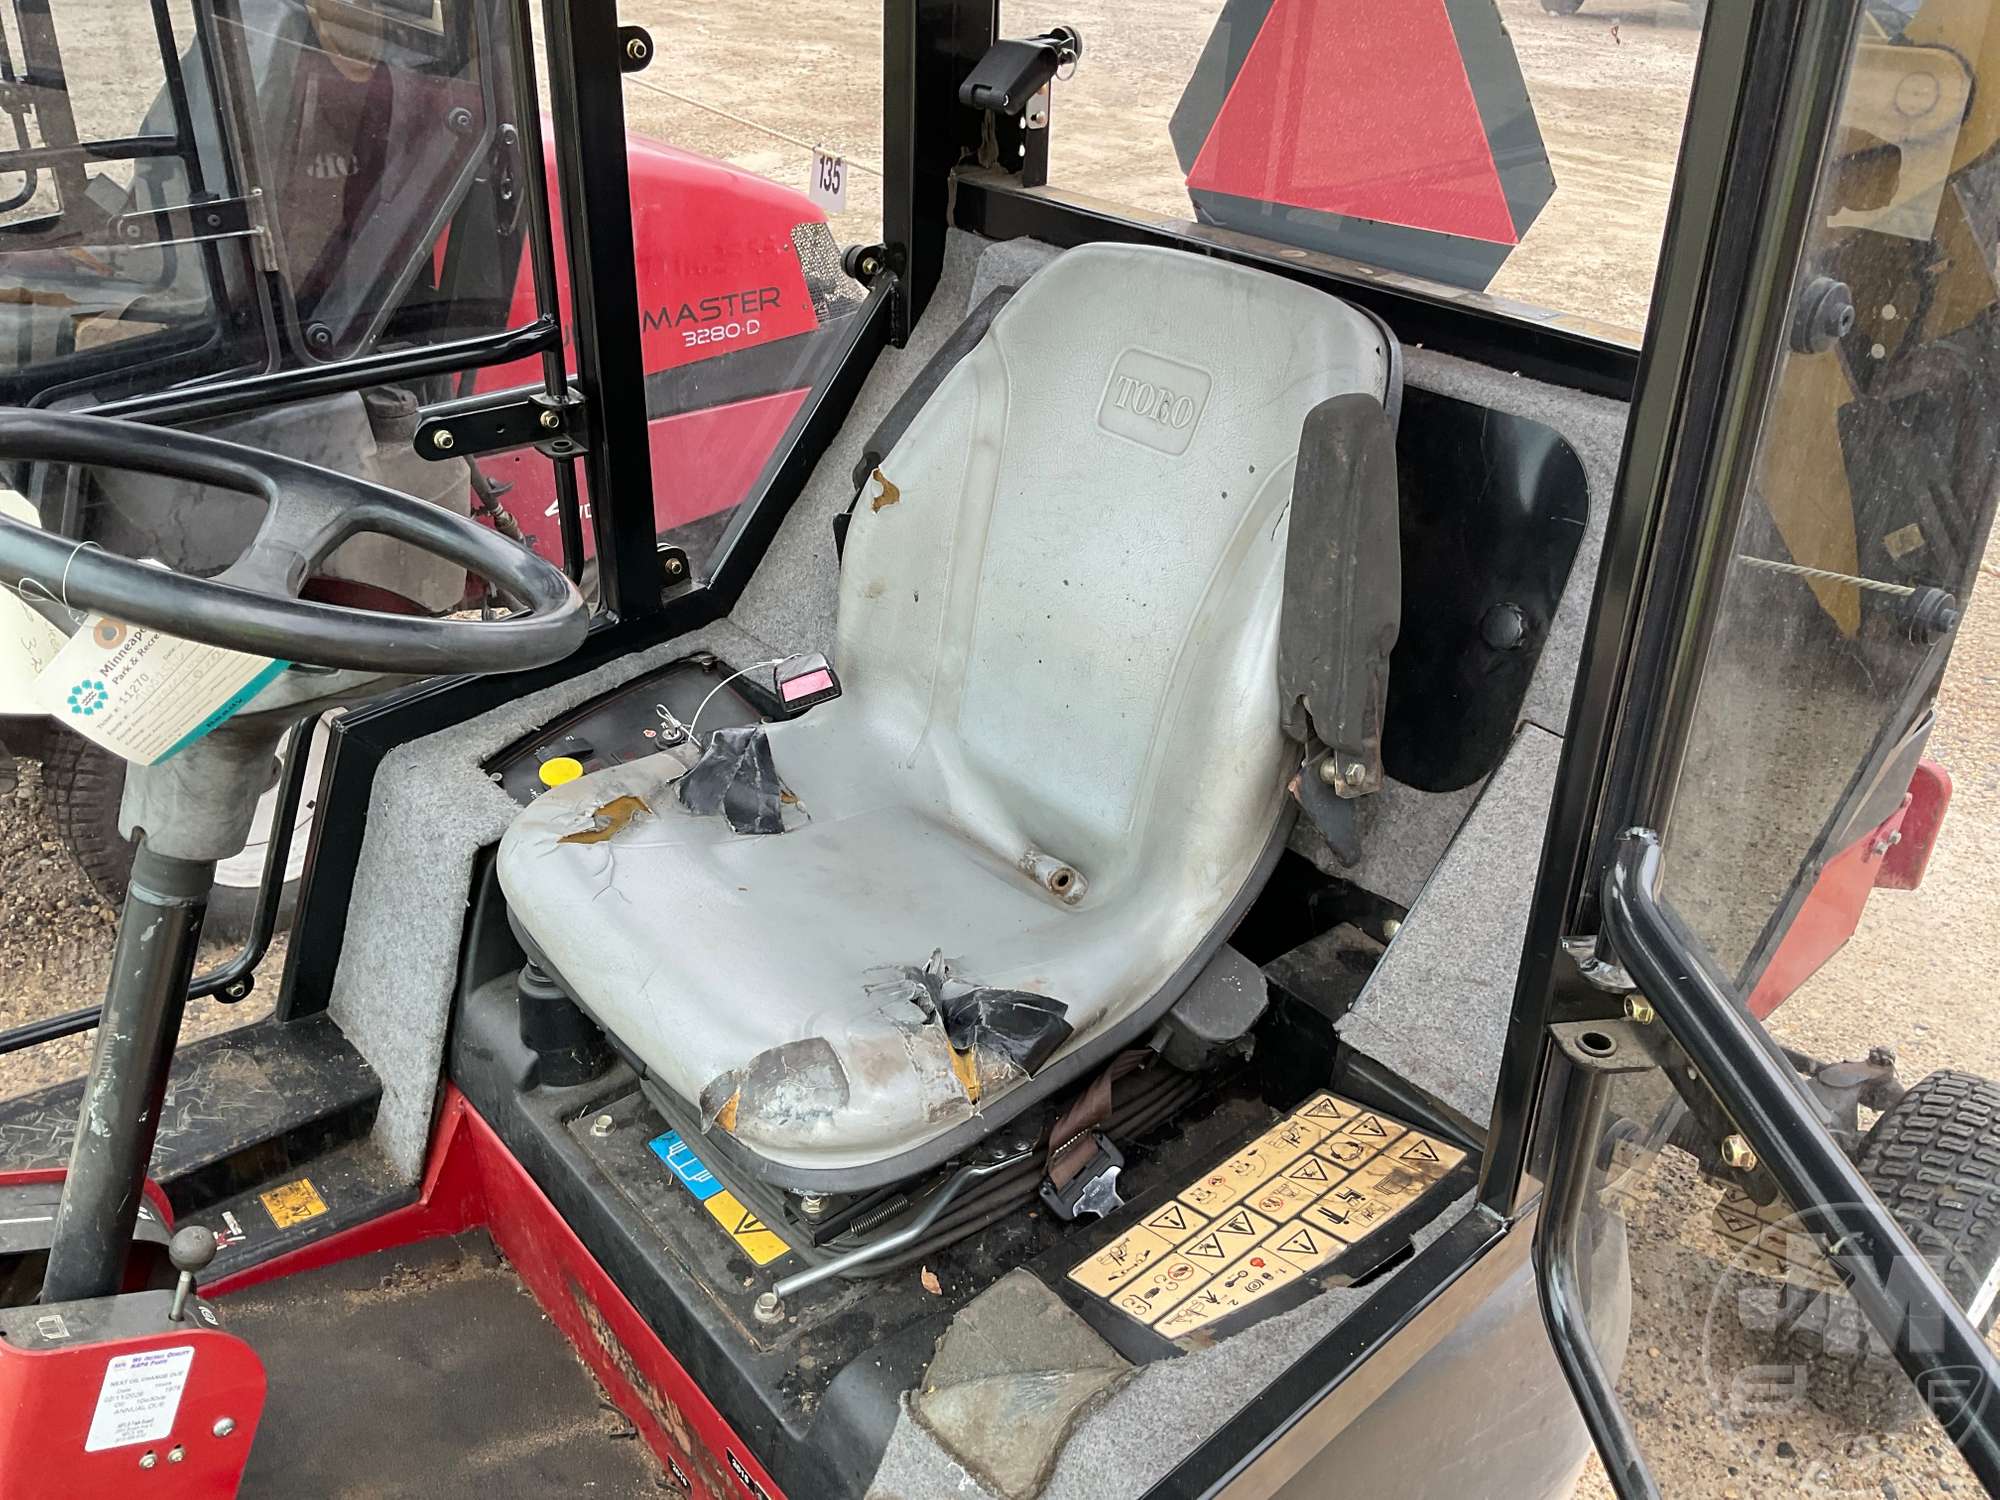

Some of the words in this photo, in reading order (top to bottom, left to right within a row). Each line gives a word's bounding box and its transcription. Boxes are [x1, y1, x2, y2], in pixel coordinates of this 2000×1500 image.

[819, 156, 841, 194] 135
[1113, 375, 1194, 430] TORO
[112, 666, 131, 685] Park
[119, 673, 149, 704] 11270
